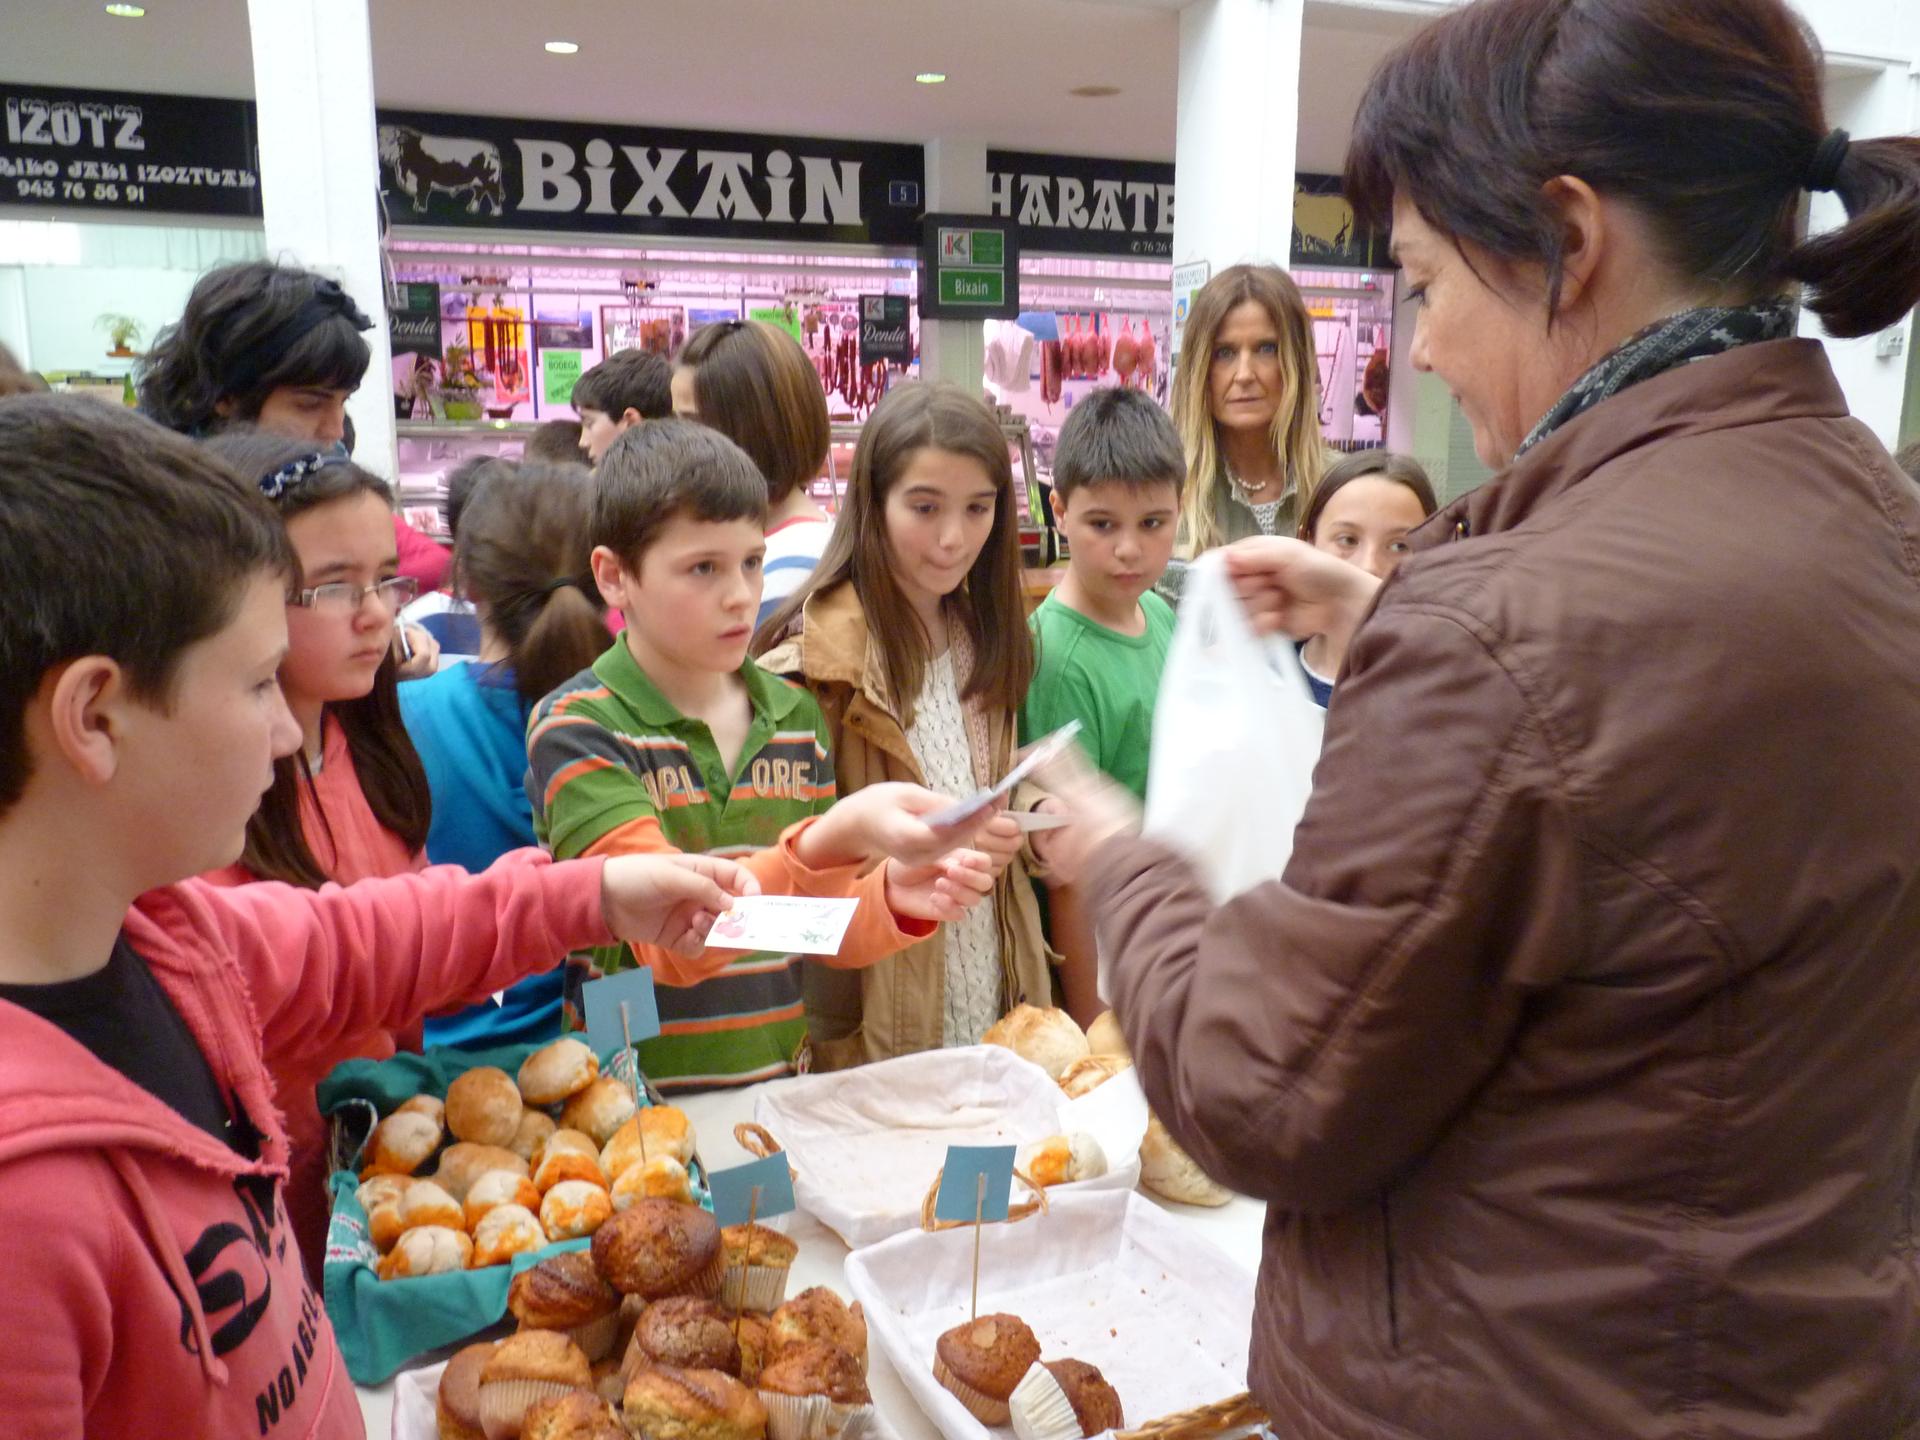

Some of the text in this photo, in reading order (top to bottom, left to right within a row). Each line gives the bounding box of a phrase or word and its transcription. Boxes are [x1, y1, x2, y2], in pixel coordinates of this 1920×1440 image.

[6, 97, 145, 150] IZOTZ
[955, 278, 989, 297] Bixain
[863, 321, 906, 343] Denda
